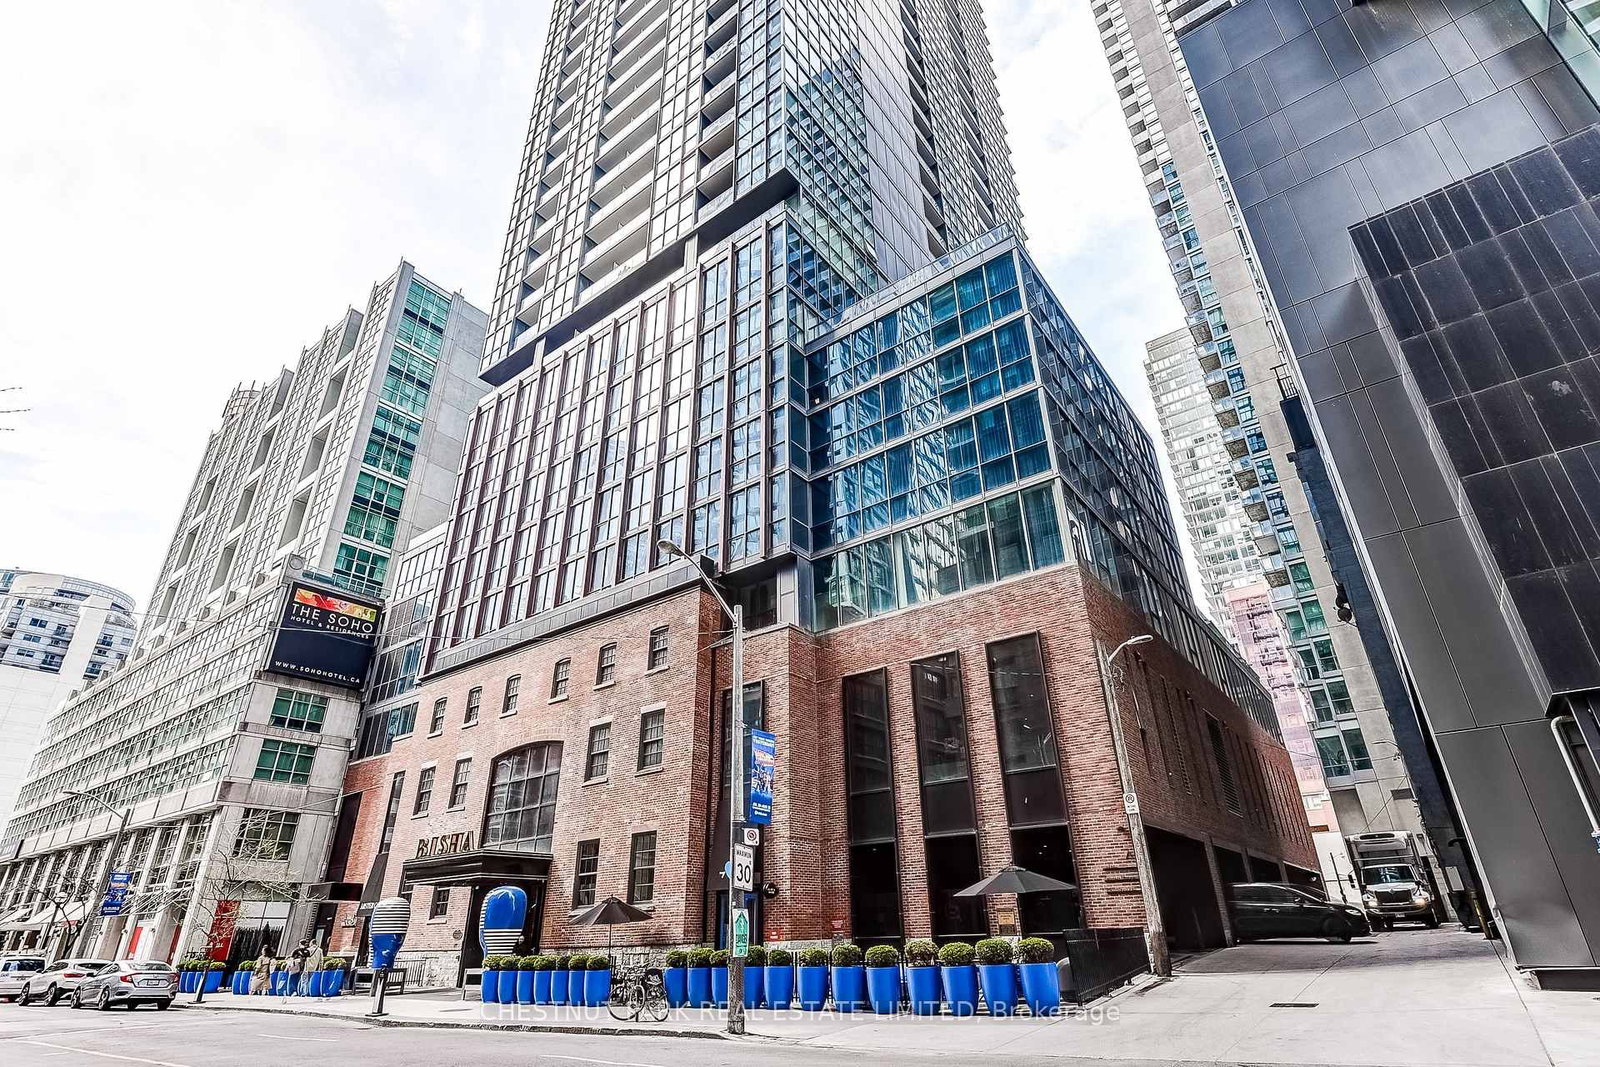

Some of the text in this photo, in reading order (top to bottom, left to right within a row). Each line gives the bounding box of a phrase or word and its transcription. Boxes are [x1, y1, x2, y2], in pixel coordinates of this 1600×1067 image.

[290, 615, 315, 626] HOTEL
[325, 624, 369, 639] RESIDENCES
[291, 603, 374, 633] THE SOHO
[275, 661, 360, 684] WWW.SOHOHOTEL.CA
[415, 831, 475, 859] BISHA
[736, 863, 751, 884] 30
